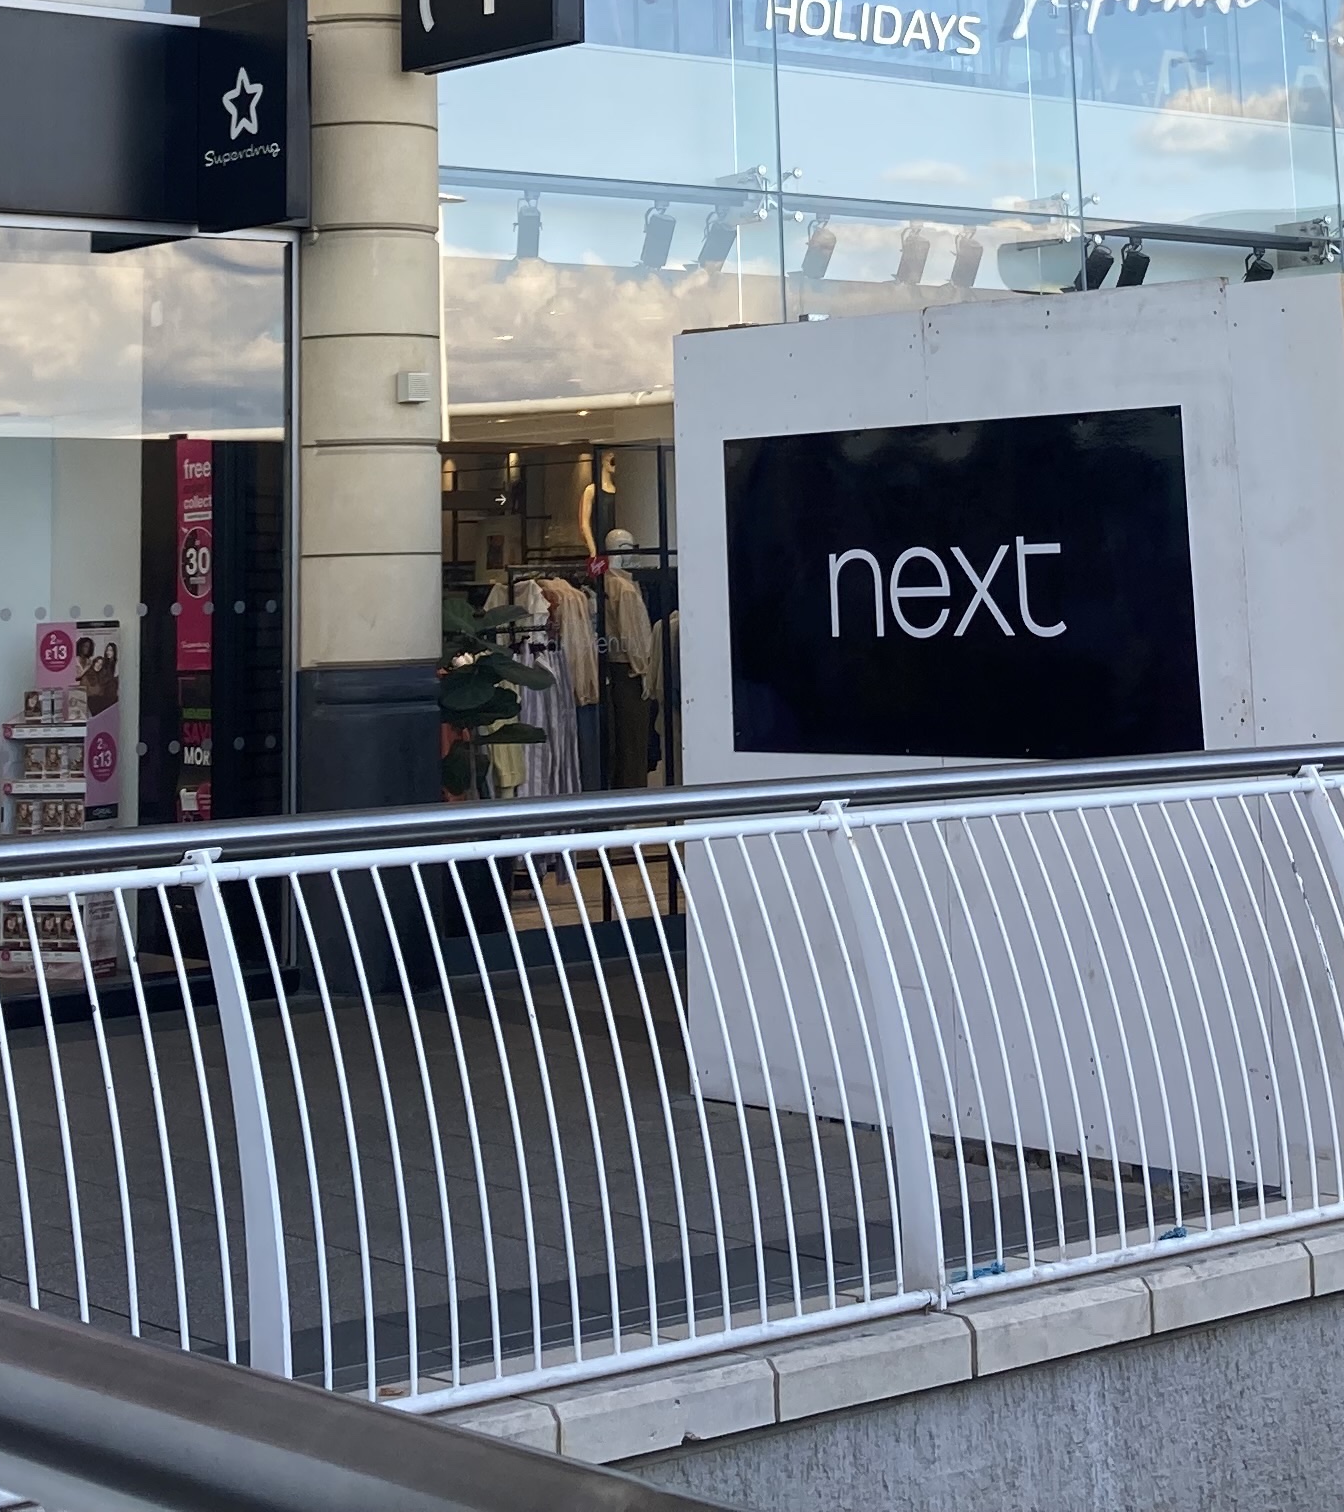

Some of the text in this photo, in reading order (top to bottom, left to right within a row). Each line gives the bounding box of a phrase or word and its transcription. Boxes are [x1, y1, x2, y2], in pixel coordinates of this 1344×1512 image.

[204, 143, 280, 167] Superdrug
[183, 458, 211, 480] free
[185, 547, 210, 575] 30
[828, 535, 1067, 639] next
[44, 645, 67, 660] £13
[93, 750, 112, 769] £13
